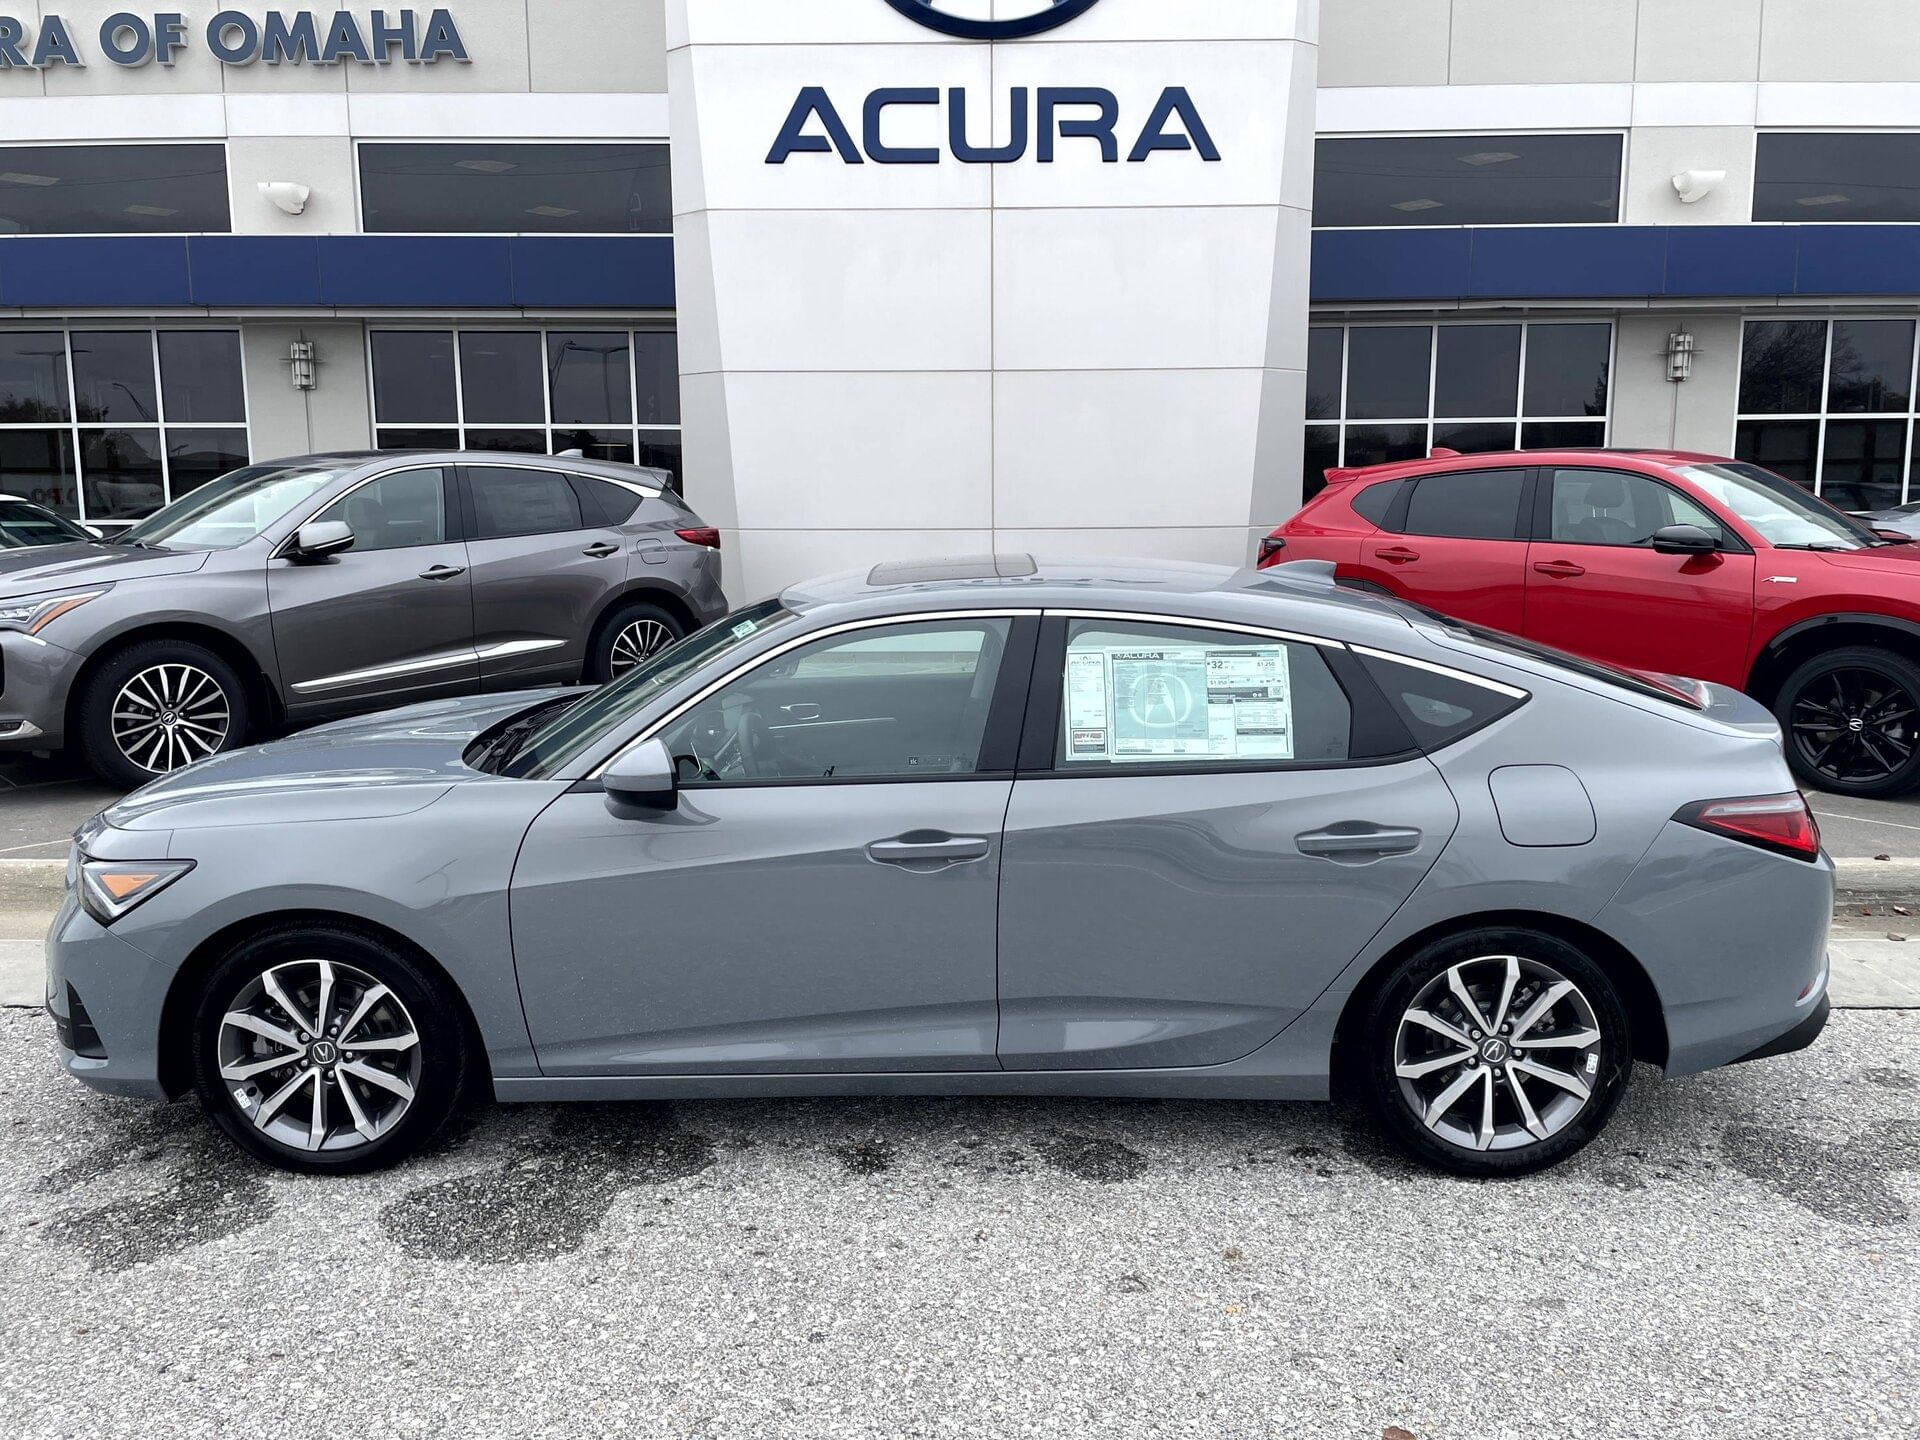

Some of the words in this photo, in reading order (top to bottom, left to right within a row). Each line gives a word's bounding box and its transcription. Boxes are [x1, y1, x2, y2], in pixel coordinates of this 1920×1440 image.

[100, 12, 187, 67] OF
[206, 9, 470, 66] OMAHA
[764, 86, 1222, 164] ACURA
[1122, 652, 1161, 660] ACURA
[1211, 661, 1223, 669] 32
